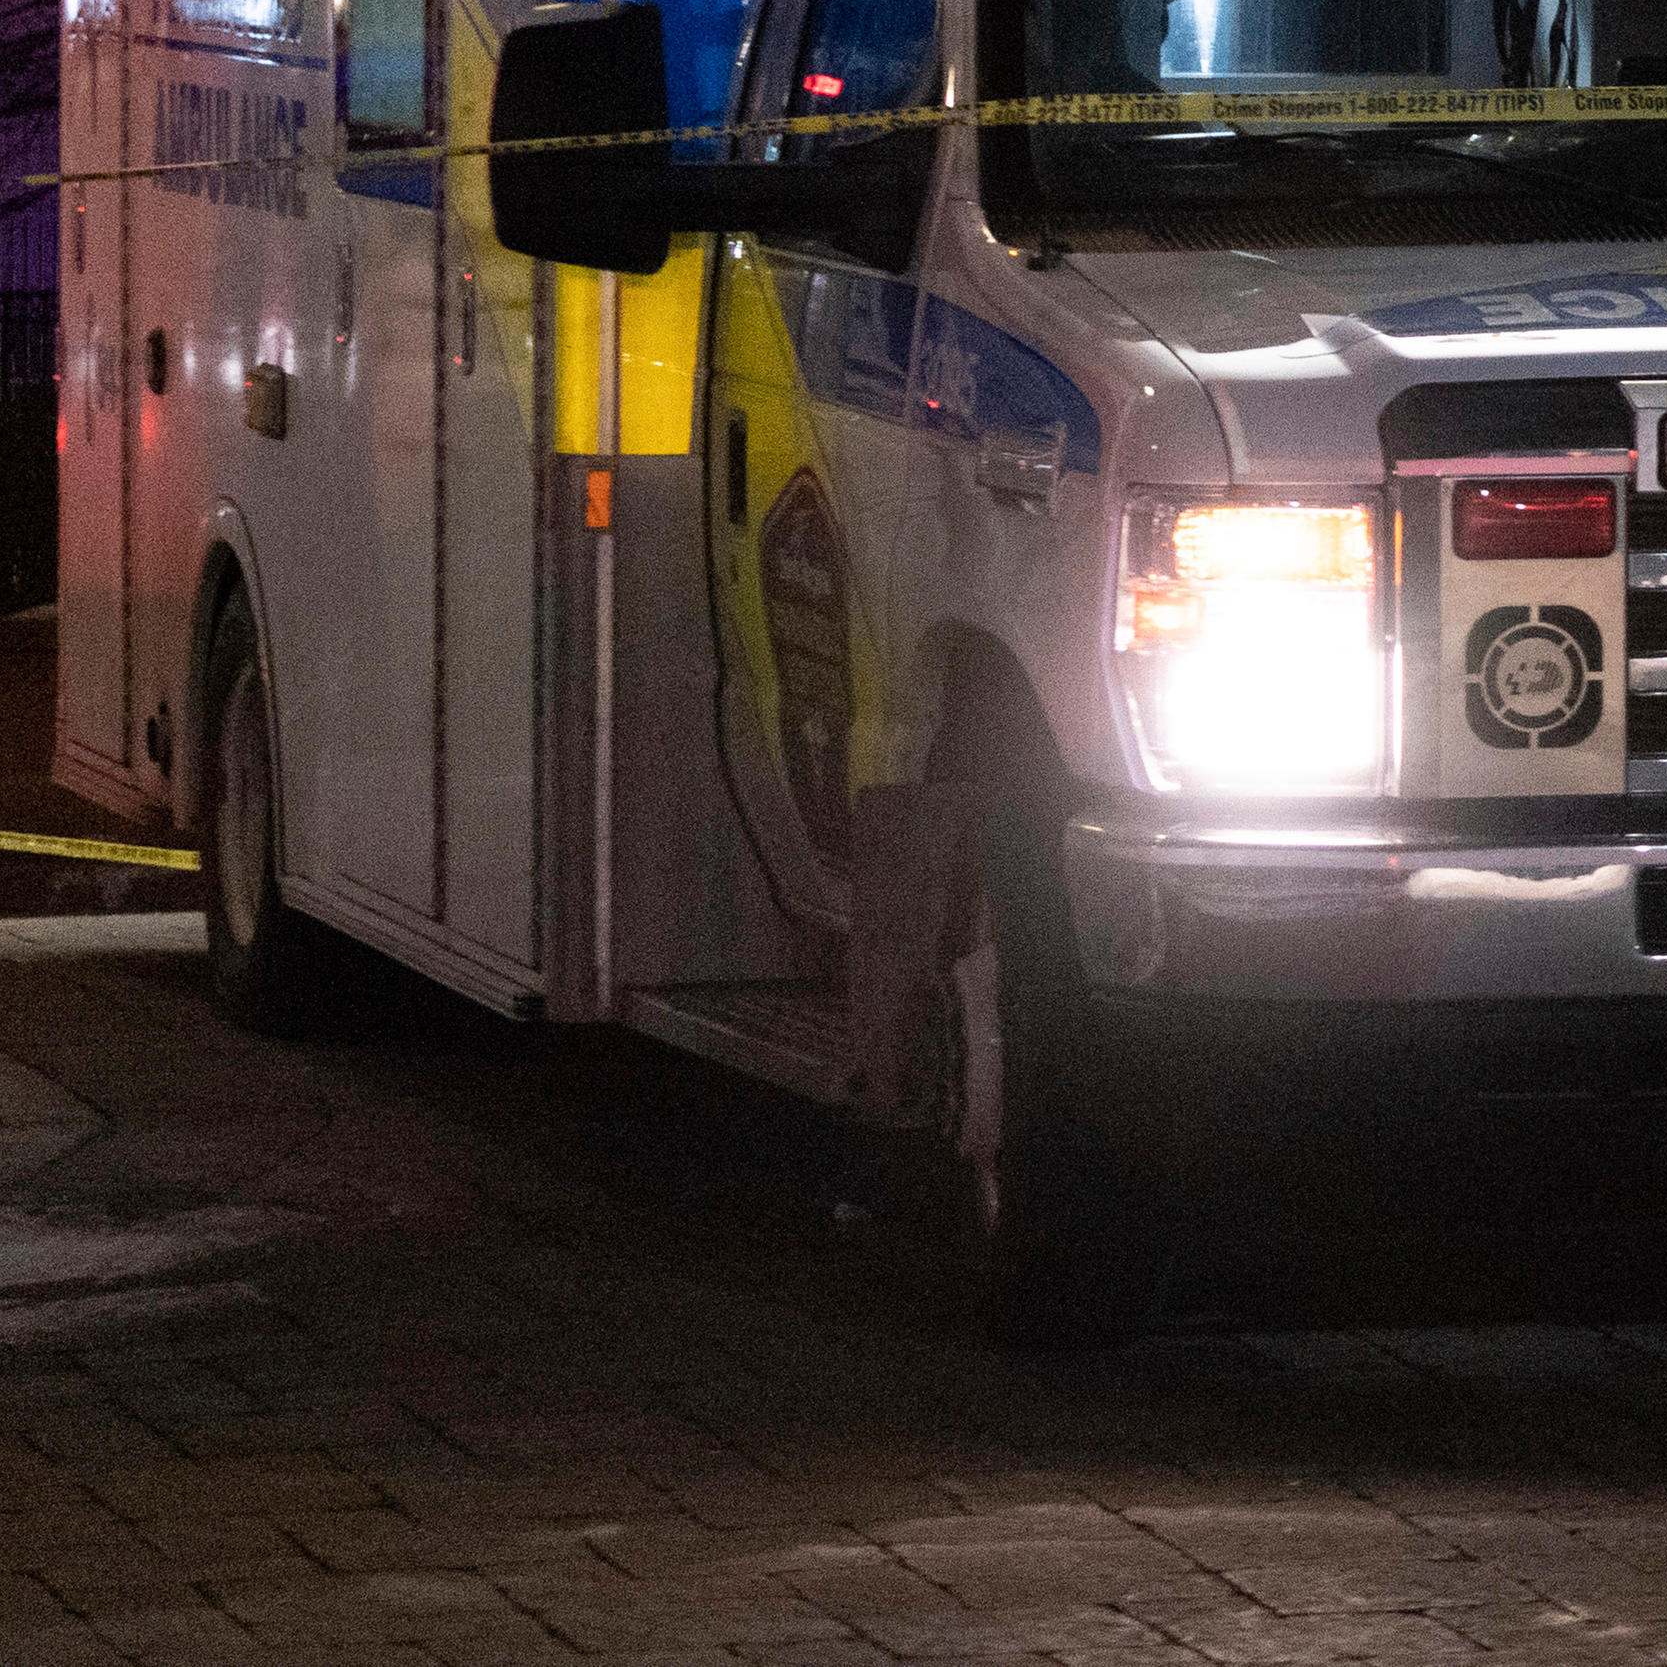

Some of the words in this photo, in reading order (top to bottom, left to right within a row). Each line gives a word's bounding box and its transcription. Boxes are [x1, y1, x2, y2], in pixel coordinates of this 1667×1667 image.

[1213, 100, 1262, 118] Crime
[1268, 99, 1342, 118] Stoppers
[1348, 95, 1489, 114] 1-800-222-8477
[1494, 94, 1546, 115] (TIPS)
[1575, 93, 1621, 111] Crime
